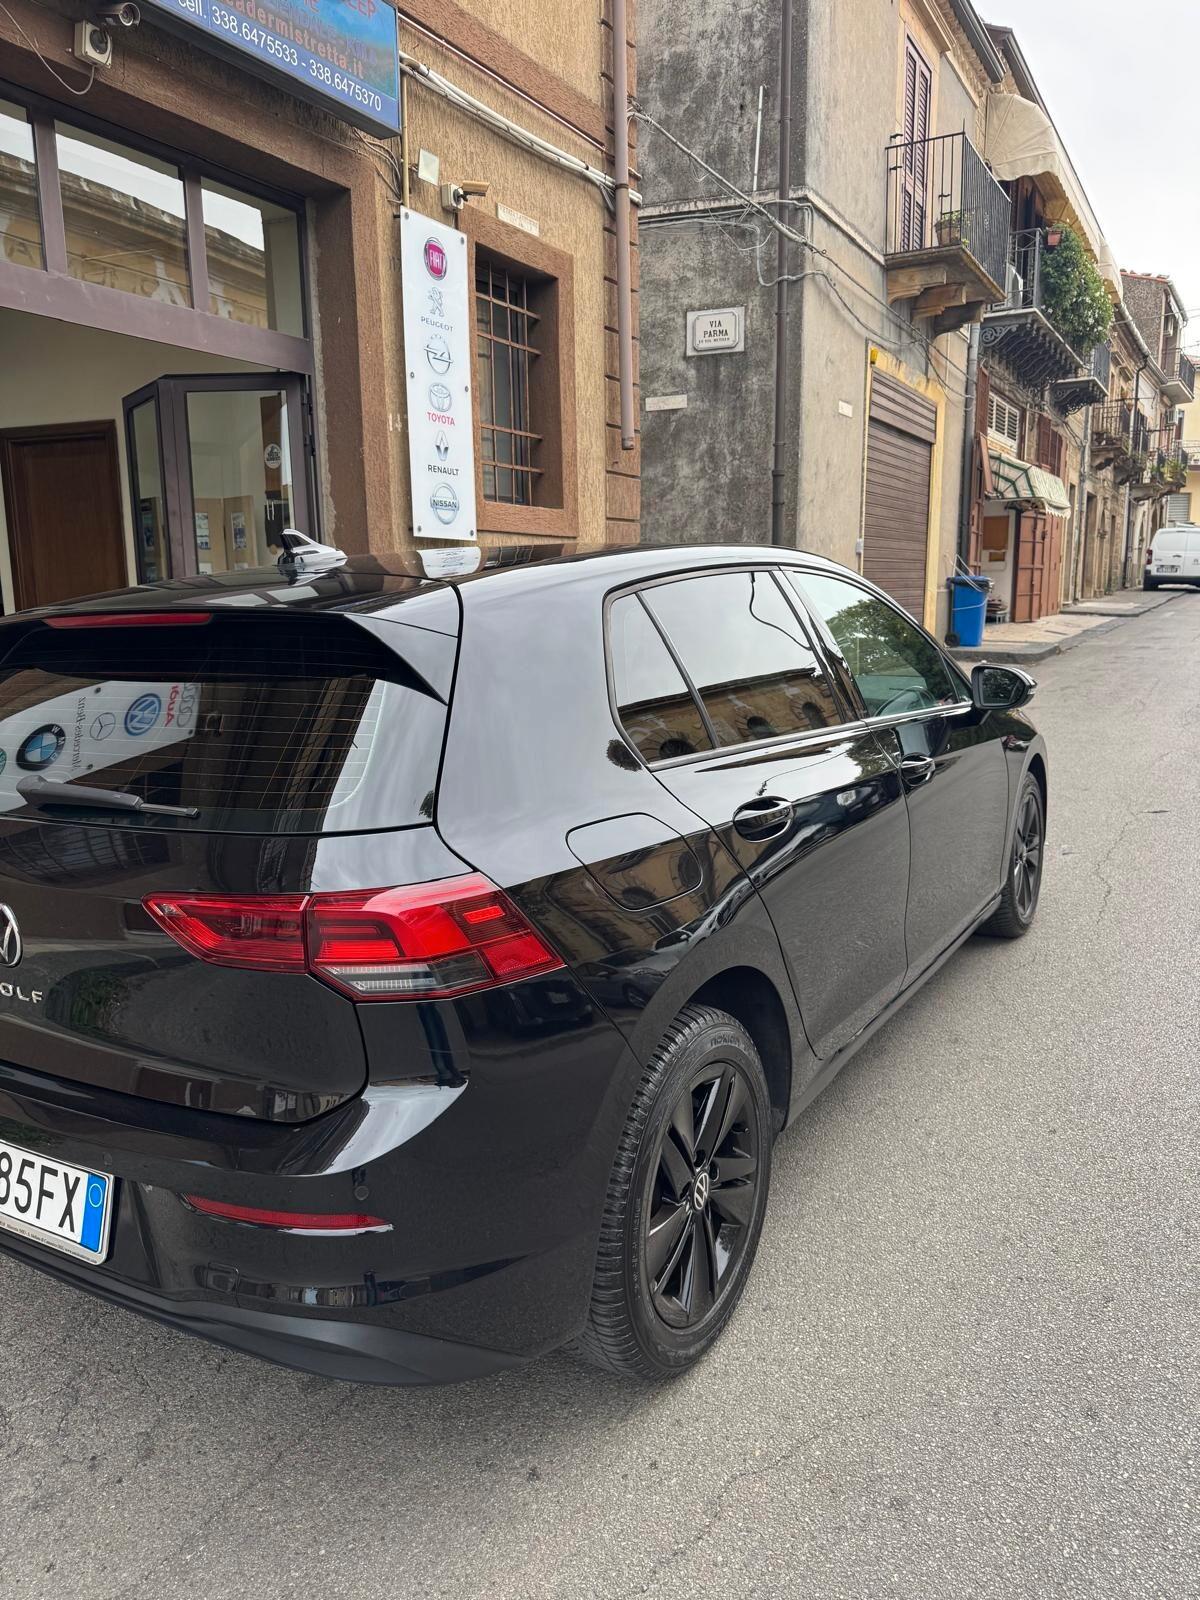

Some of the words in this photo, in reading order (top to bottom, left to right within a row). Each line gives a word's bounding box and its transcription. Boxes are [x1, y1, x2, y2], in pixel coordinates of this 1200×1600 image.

[178, 0, 207, 19] cell.
[211, 6, 298, 66] 338.6475533
[309, 59, 382, 112] 338.6475370
[429, 248, 443, 270] FIAT
[420, 316, 454, 332] PEUGEOT
[709, 320, 722, 328] VIA
[703, 329, 729, 338] PARMA
[426, 411, 456, 427] TOYOTA
[427, 464, 459, 477] RENAULT
[432, 499, 457, 509] NISSAN
